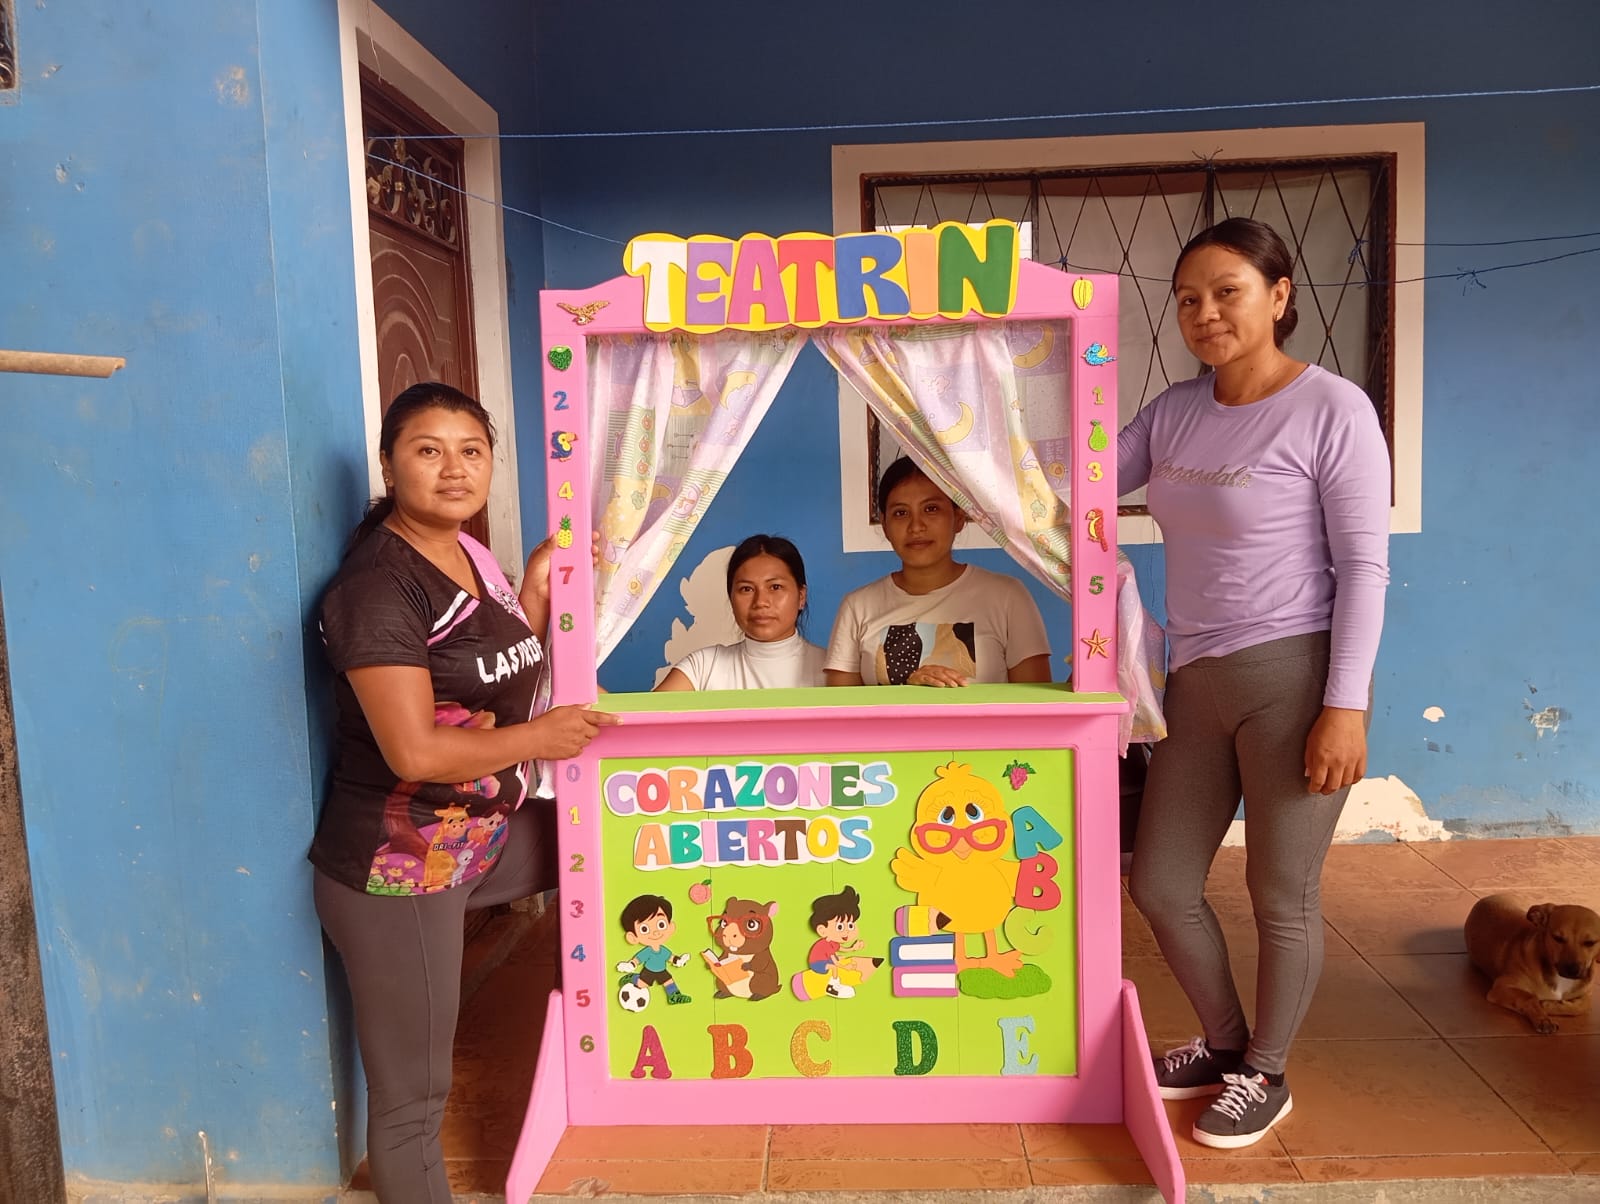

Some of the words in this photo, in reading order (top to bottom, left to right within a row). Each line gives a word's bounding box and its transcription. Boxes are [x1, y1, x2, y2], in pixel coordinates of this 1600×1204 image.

[630, 225, 1015, 325] TEATRIN
[552, 390, 570, 411] 2
[1092, 386, 1105, 405] 1
[1086, 461, 1104, 482] 3
[558, 481, 574, 500] 4
[558, 566, 575, 585] 7
[1088, 575, 1105, 595] 5
[558, 613, 574, 633] 8
[606, 764, 896, 815] CORAZONES
[568, 805, 581, 826] 1
[634, 817, 873, 866] ABIERTOS
[569, 853, 585, 873] 2
[569, 900, 585, 918] 3
[570, 943, 586, 962] 4
[576, 989, 591, 1008] 5
[580, 1034, 595, 1053] 6
[631, 1025, 672, 1080] A
[707, 1023, 754, 1080] B
[790, 1020, 832, 1077] C
[892, 1019, 939, 1076] D
[997, 1014, 1039, 1076] E
